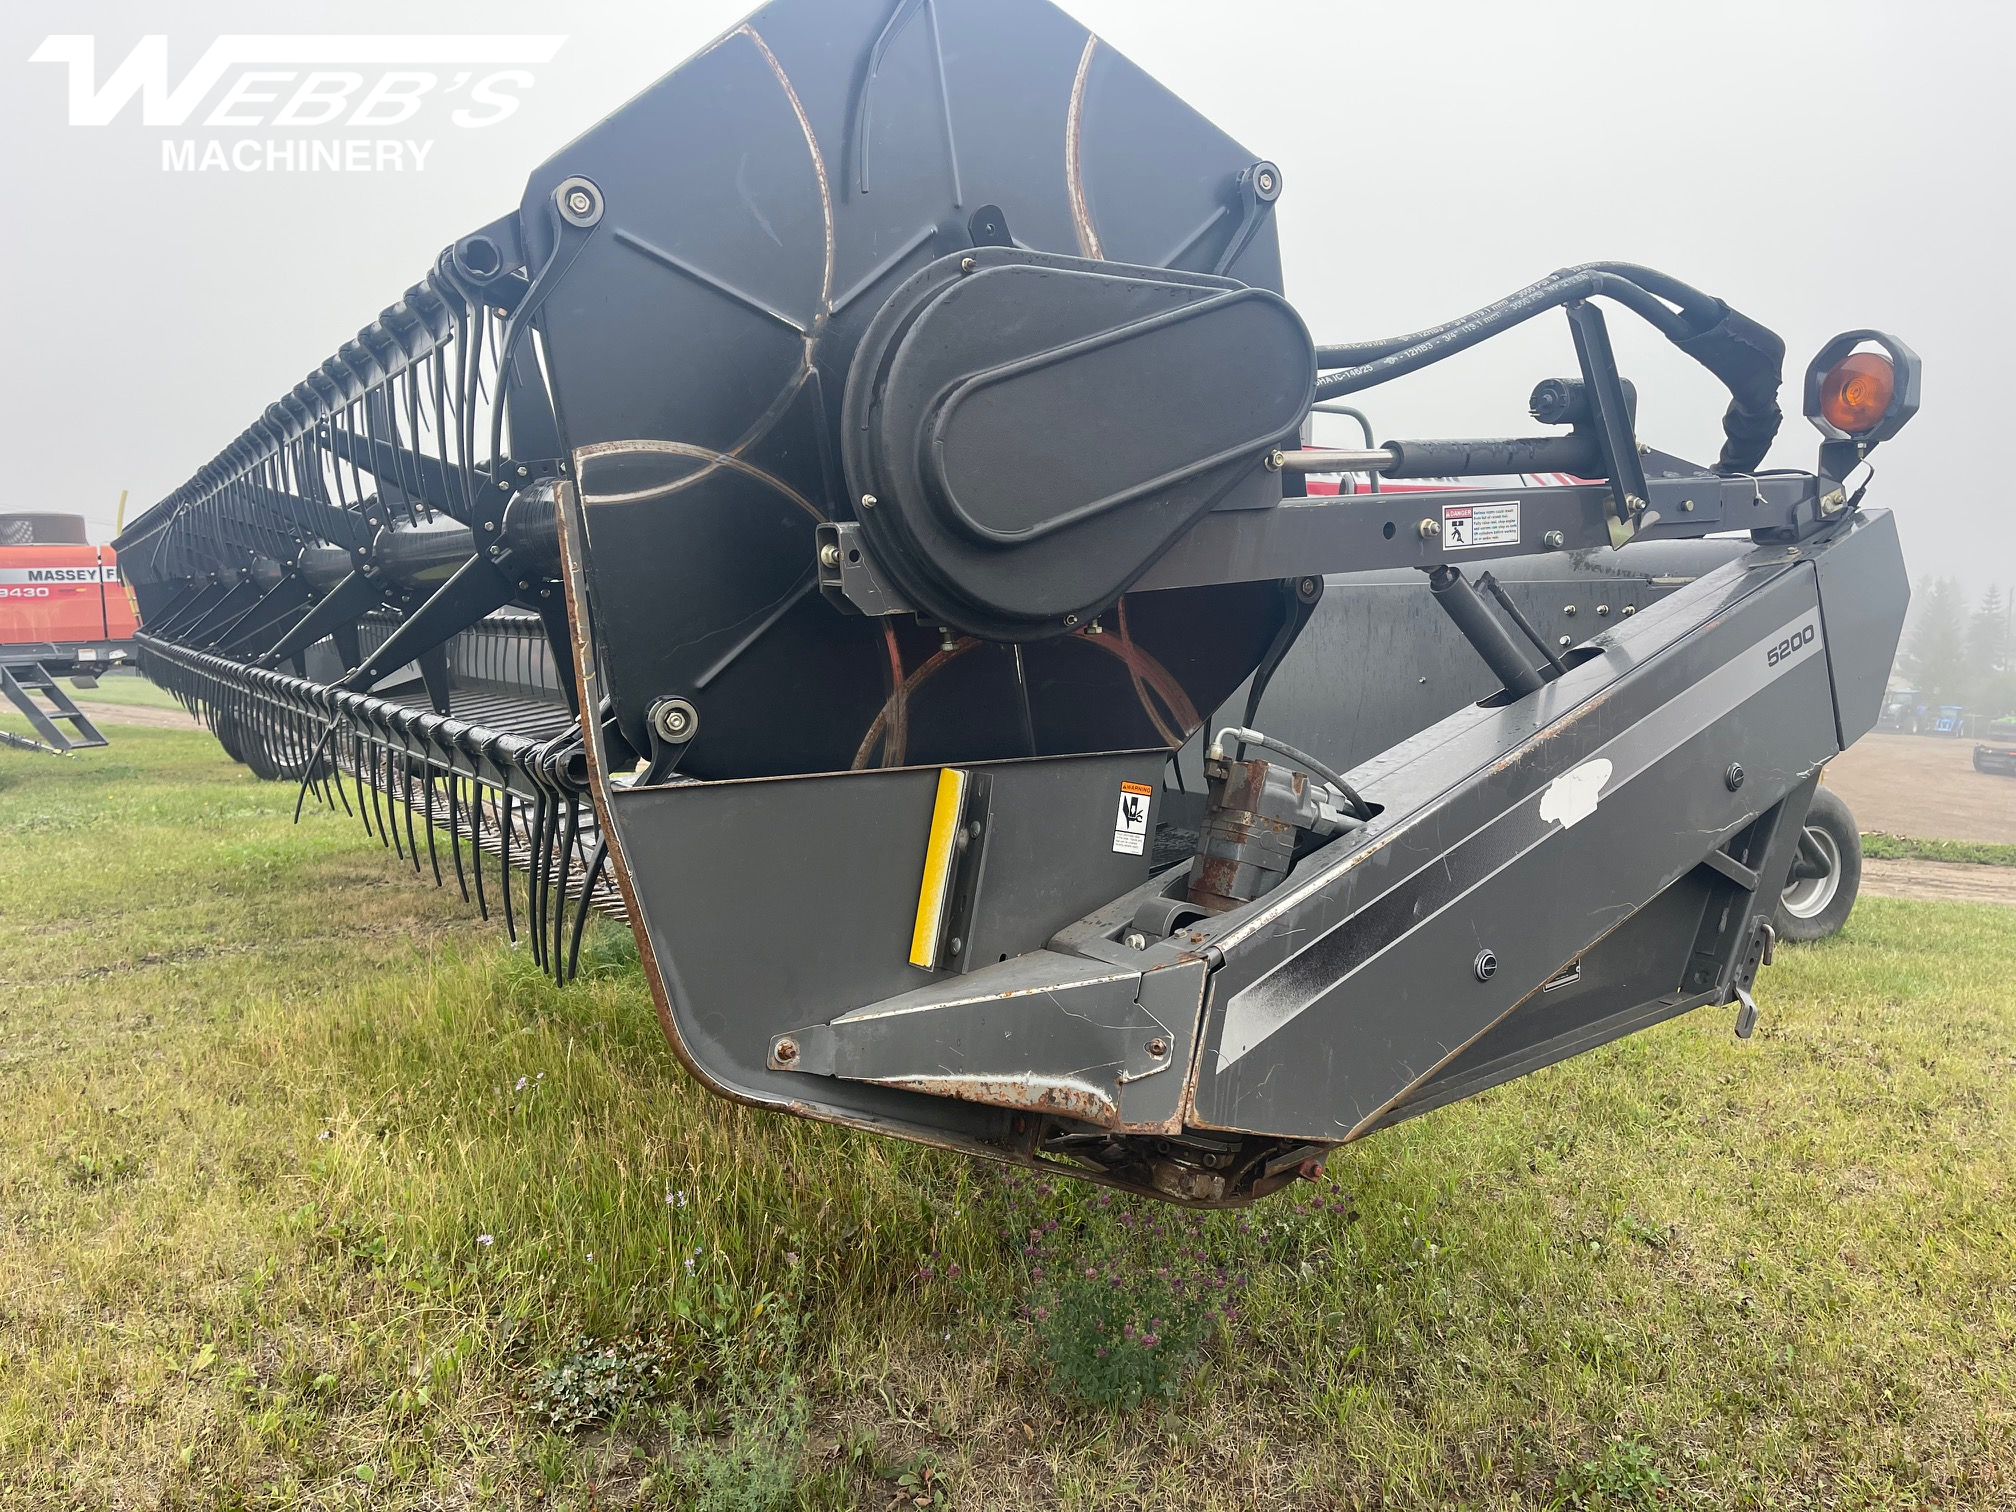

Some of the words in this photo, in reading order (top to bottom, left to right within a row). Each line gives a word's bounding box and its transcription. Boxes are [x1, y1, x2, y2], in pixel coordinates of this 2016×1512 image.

[1516, 286, 1536, 298] 3000
[1404, 342, 1434, 358] 12HB3
[1510, 297, 1531, 310] 3000
[1530, 290, 1545, 301] PSI
[1451, 509, 1472, 517] DANGER
[28, 569, 97, 582] MASSEY
[0, 587, 49, 598] 9430
[1767, 624, 1815, 667] 5200
[1127, 784, 1151, 793] WARNING
